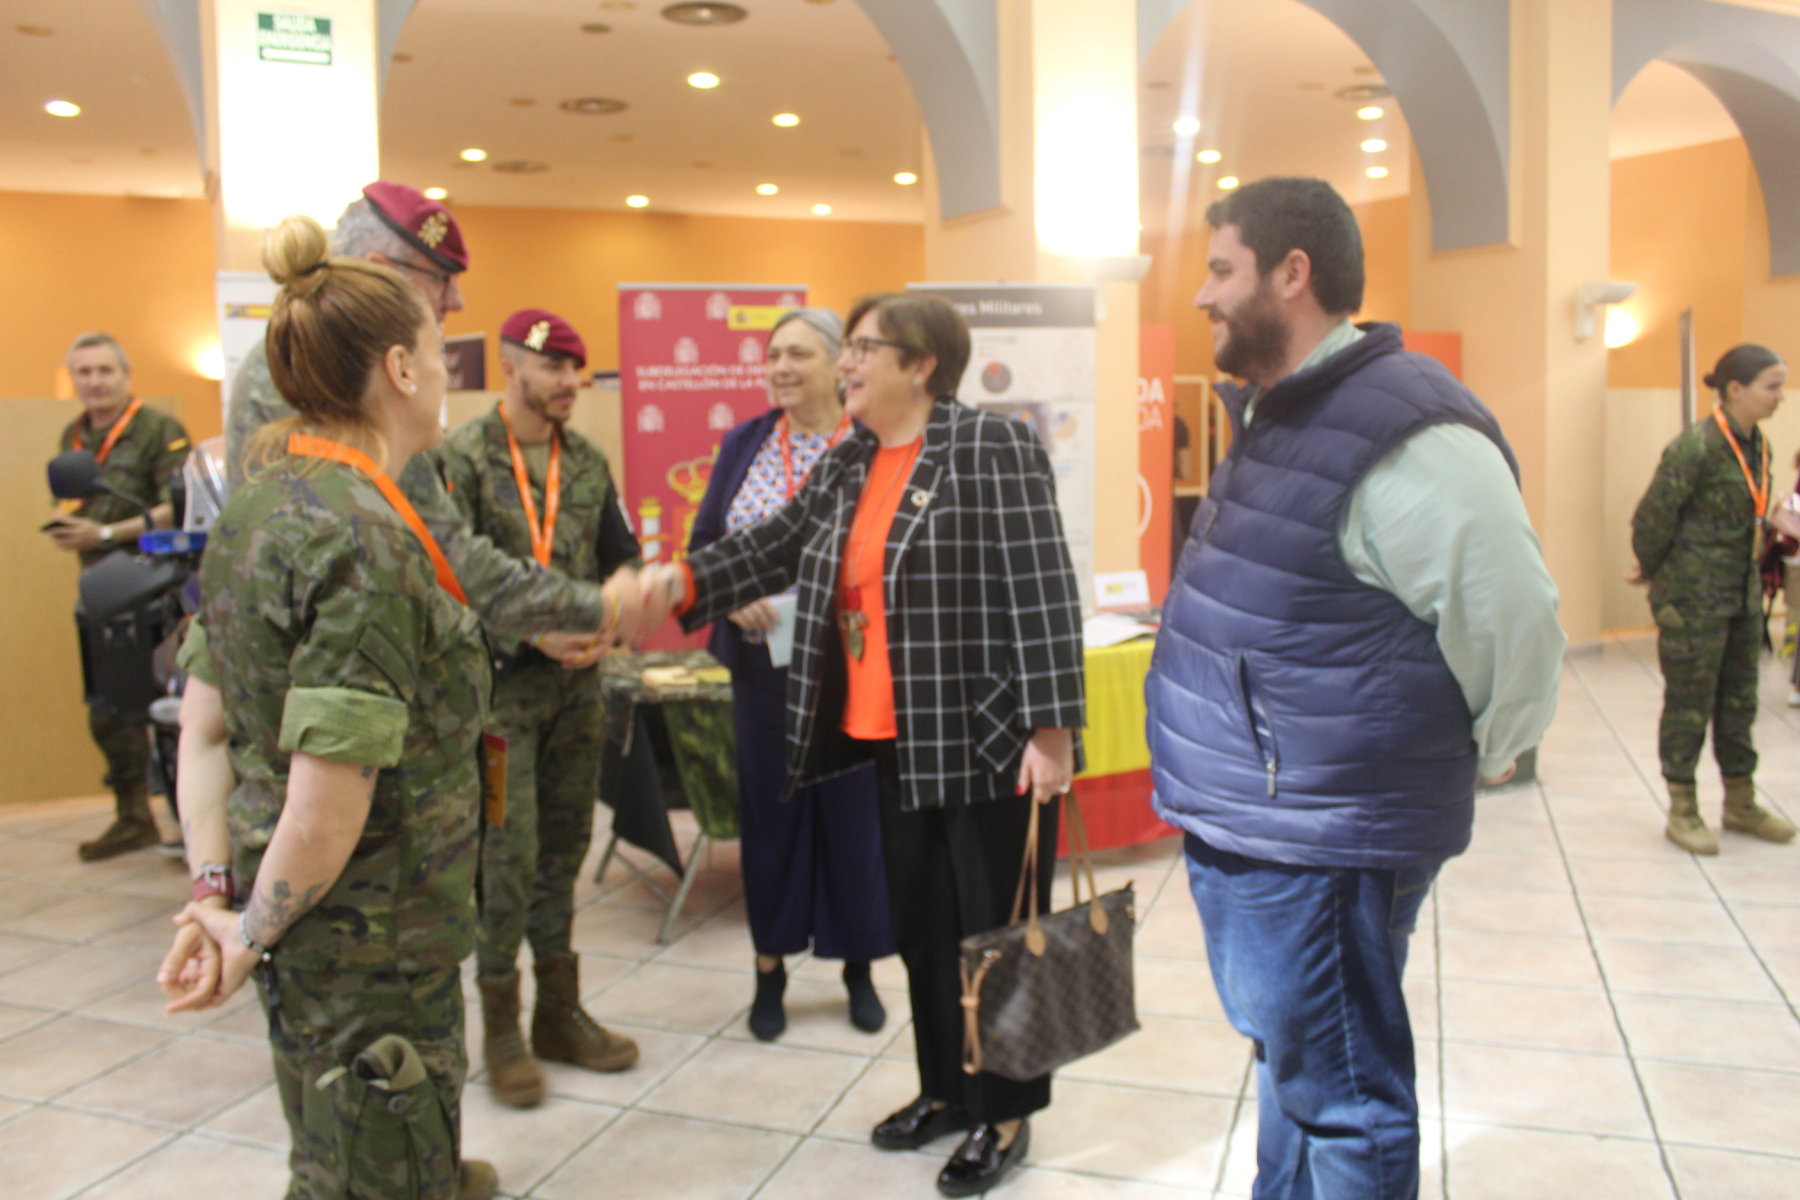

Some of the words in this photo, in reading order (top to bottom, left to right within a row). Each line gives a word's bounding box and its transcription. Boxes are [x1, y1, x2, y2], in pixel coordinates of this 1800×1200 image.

[978, 300, 1043, 316] Militares
[635, 363, 727, 378] SUBDELEGACIÓN
[728, 364, 744, 376] DE
[637, 379, 655, 392] EN
[656, 376, 724, 391] CASTELLÓN
[724, 377, 738, 391] DE
[739, 377, 753, 390] LA
